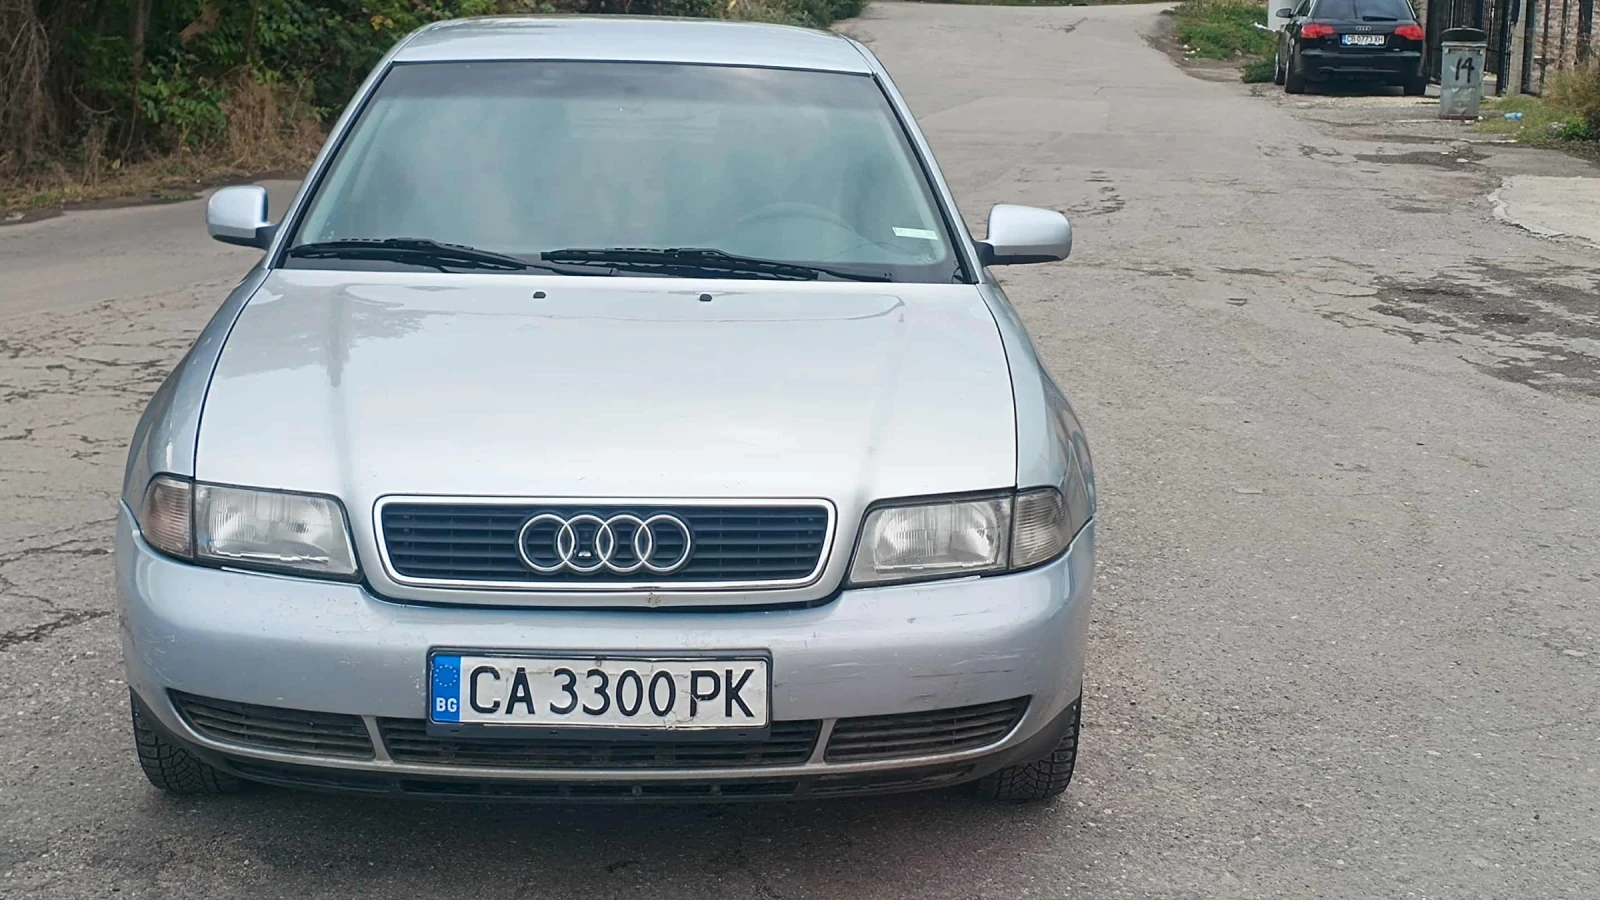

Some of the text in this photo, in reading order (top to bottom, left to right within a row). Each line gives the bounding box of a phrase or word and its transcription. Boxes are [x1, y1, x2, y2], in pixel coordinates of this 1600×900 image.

[1455, 57, 1475, 84] 14
[435, 696, 458, 713] BG
[469, 665, 756, 718] CA 3300 PK
